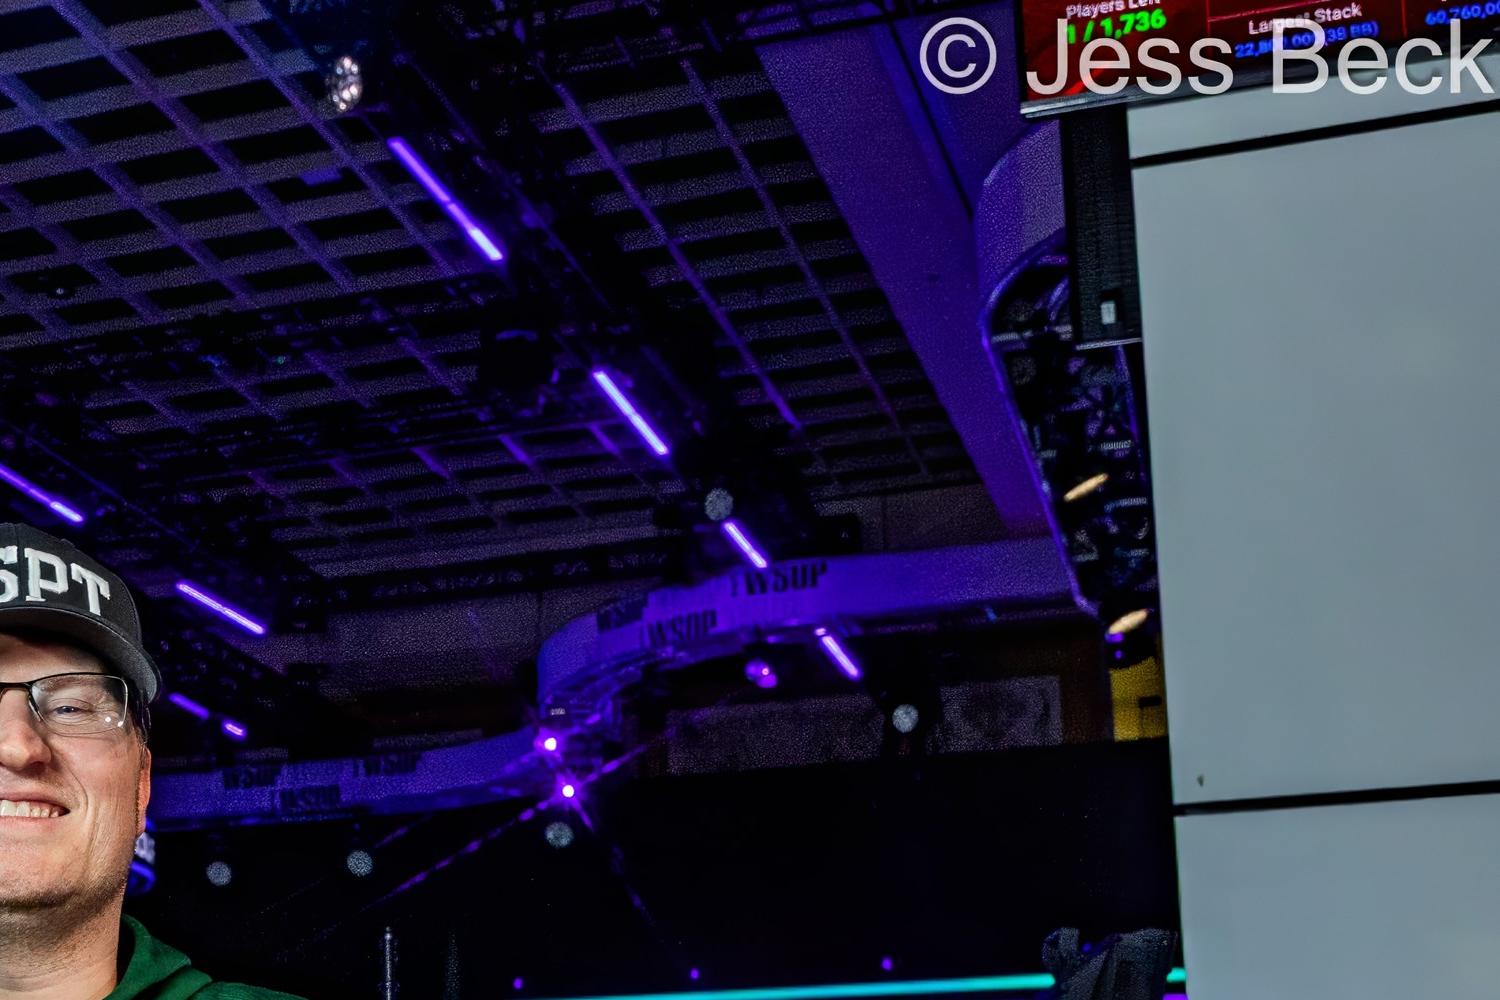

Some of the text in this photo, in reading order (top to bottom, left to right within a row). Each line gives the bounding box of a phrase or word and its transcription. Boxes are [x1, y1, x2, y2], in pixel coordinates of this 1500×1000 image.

[1066, 1, 1125, 19] Players
[1314, 3, 1362, 23] Stack
[1099, 8, 1167, 39] 1,736
